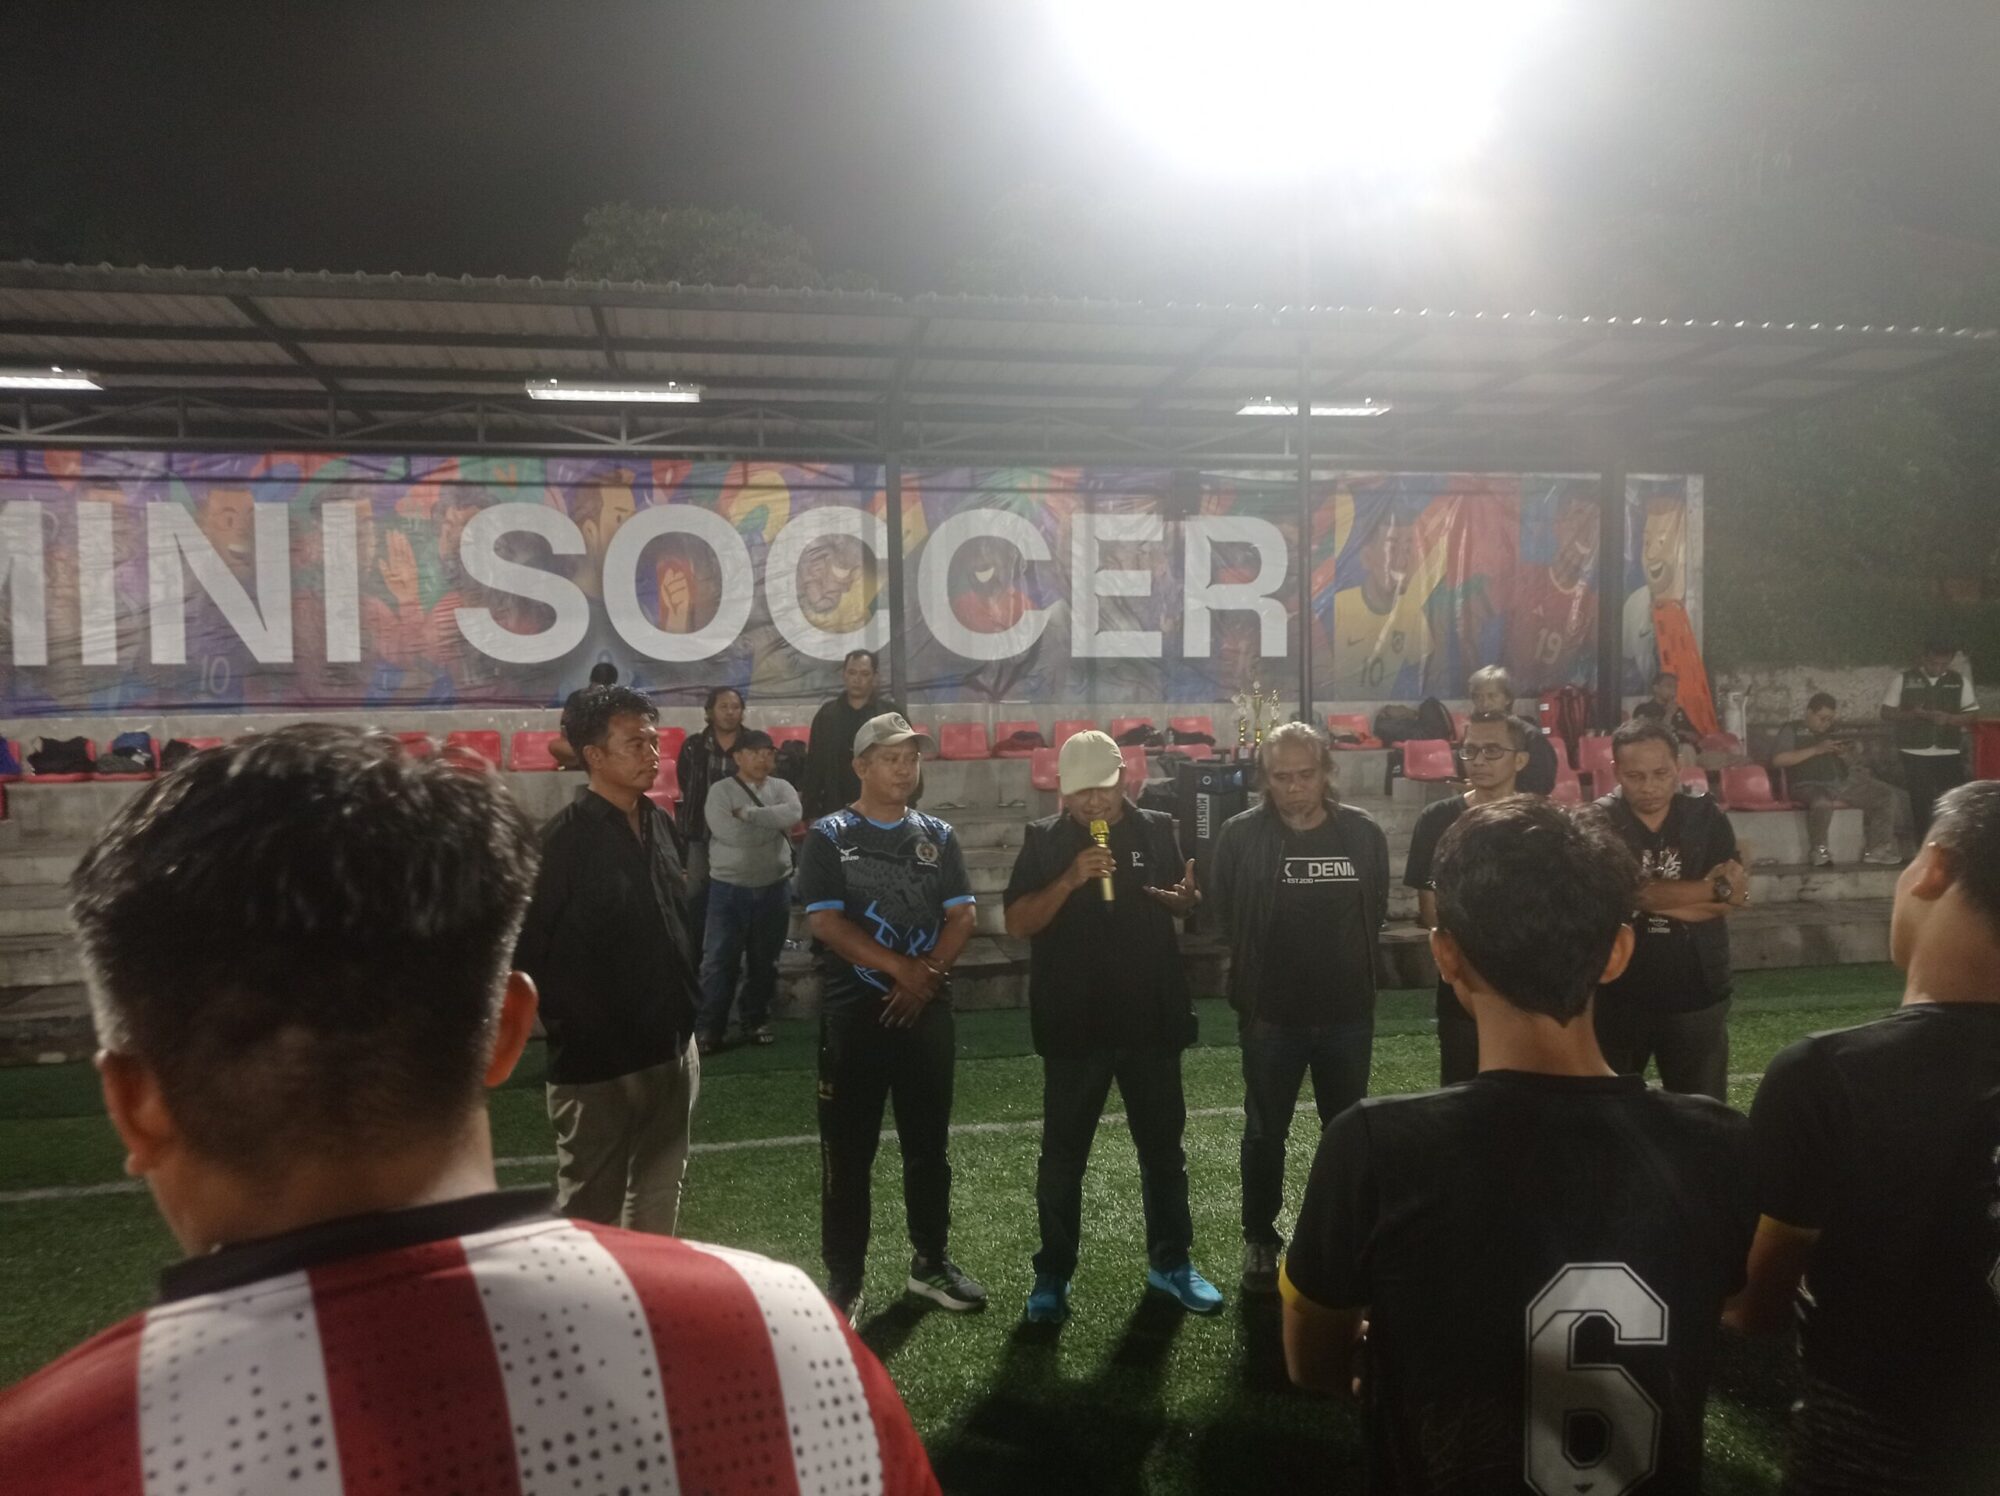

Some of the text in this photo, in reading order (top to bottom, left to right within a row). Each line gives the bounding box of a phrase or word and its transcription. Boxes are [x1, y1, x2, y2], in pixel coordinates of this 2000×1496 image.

[454, 500, 1289, 665] SOCCER
[1534, 627, 1562, 665] 19
[1525, 1261, 1669, 1496] 6
